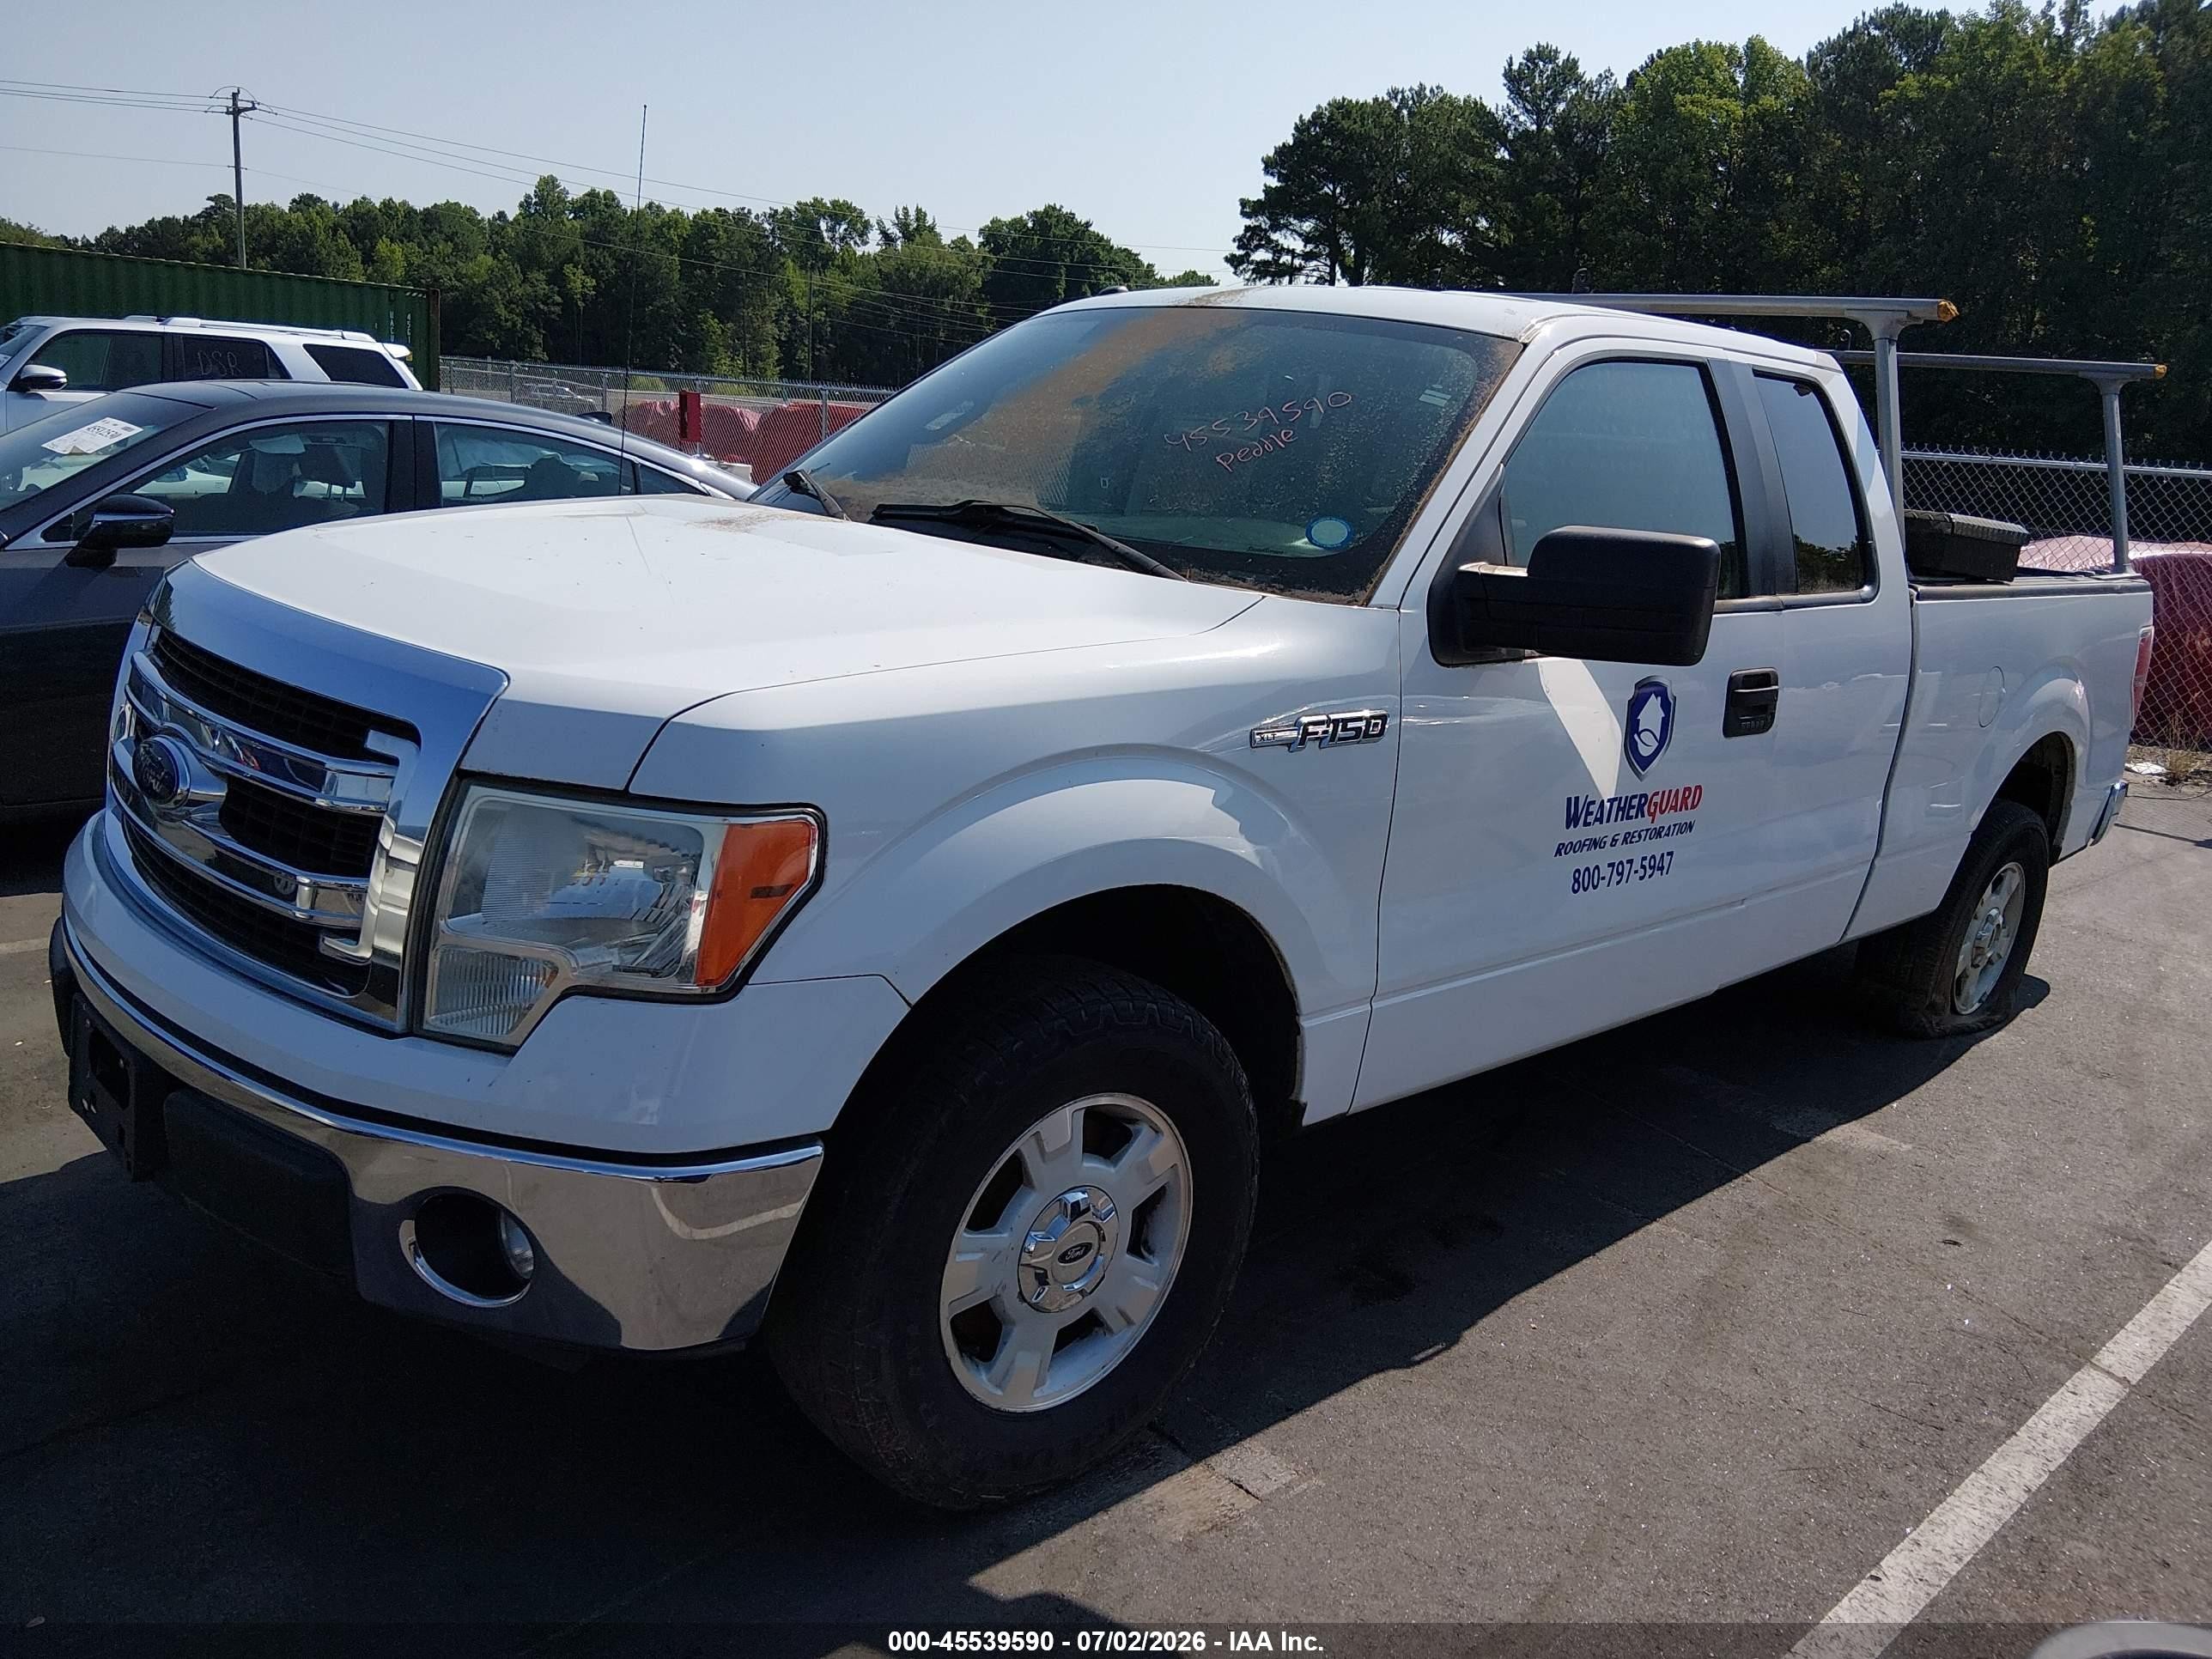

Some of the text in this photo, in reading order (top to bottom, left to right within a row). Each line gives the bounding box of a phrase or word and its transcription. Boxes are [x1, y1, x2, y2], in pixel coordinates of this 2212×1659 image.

[1164, 392, 1352, 452] 45539590
[1258, 733, 1278, 742] XLT
[1295, 711, 1389, 750] F-150
[1553, 819, 1696, 858] ROOFING & RESTORATION
[1571, 850, 1674, 895] 800-797-5947
[1064, 1246, 1085, 1261] Ford
